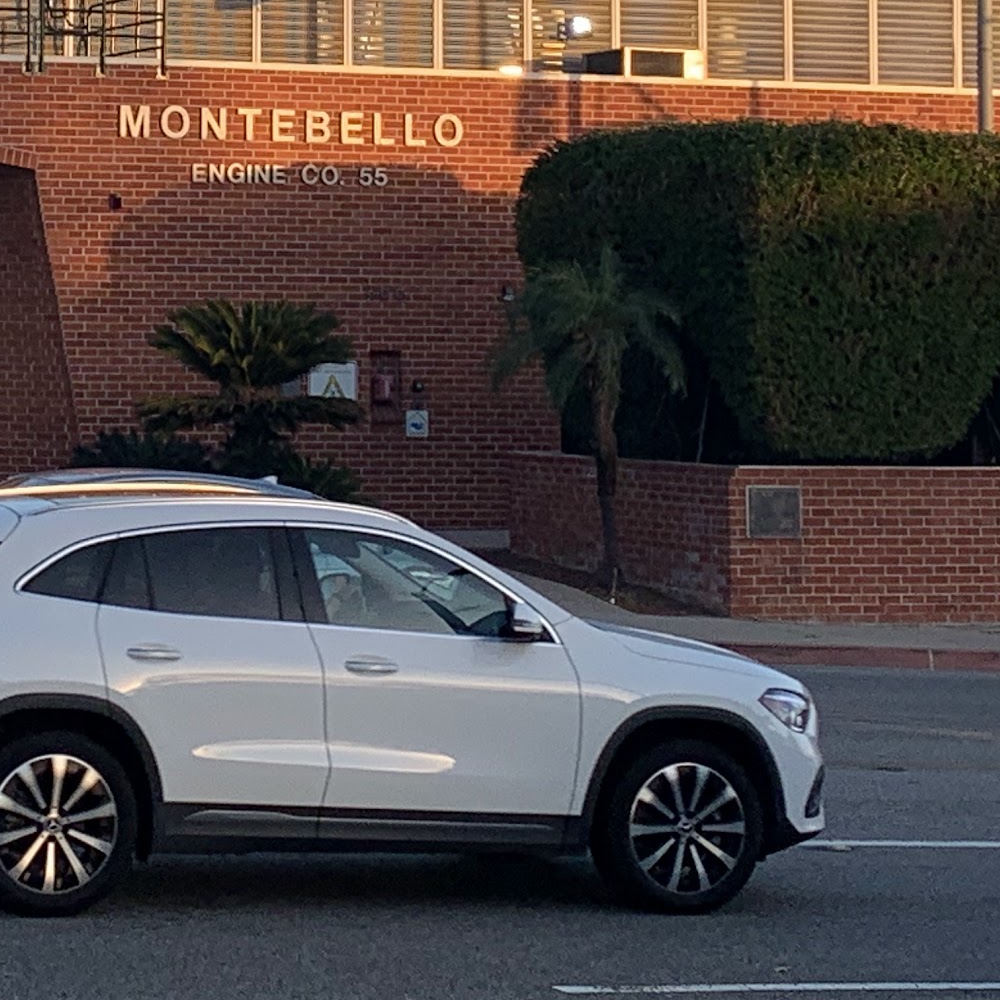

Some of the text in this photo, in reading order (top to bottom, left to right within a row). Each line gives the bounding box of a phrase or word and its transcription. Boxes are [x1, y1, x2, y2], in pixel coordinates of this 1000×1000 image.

[118, 104, 464, 147] MONTEBELLO
[191, 163, 388, 187] ENGINE CO. 55
